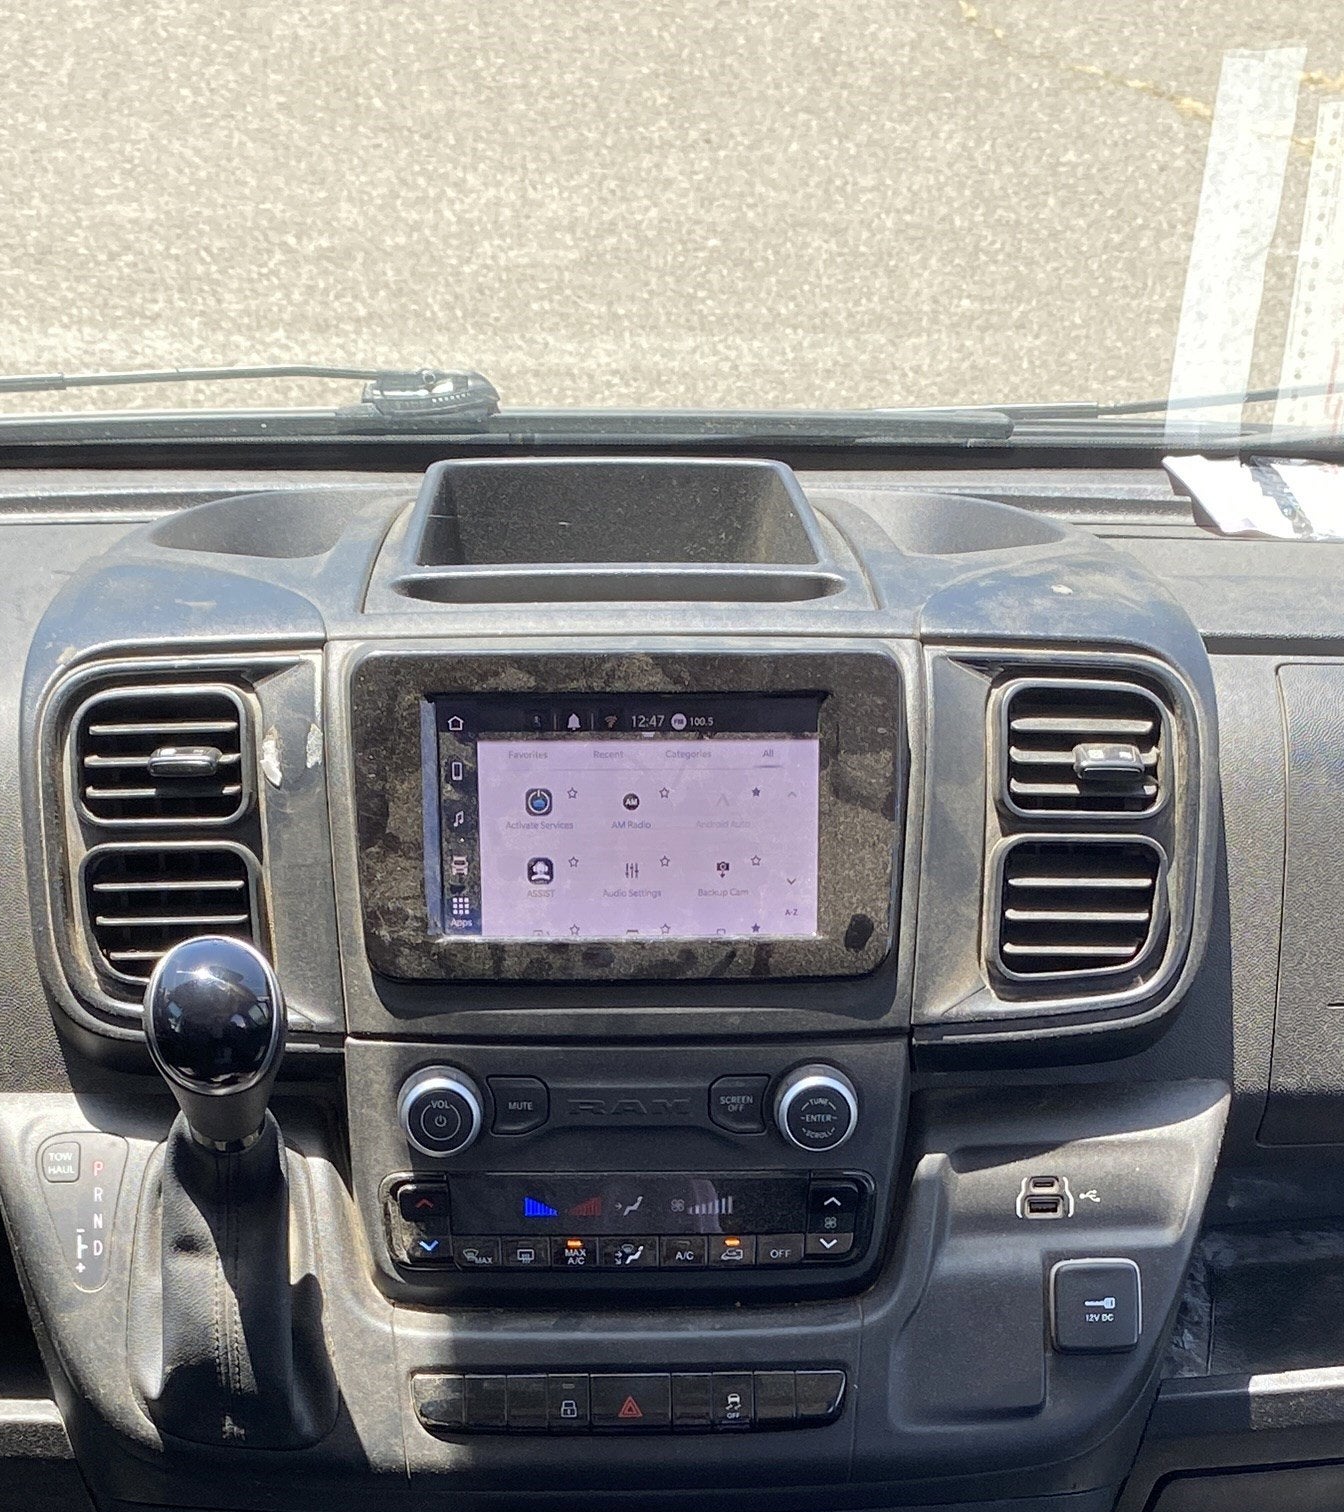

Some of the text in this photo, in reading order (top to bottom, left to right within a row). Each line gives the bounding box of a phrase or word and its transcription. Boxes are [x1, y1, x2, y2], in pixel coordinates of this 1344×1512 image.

[631, 715, 665, 728] 12:47
[690, 717, 715, 727] 100.5
[508, 750, 549, 760] Favorites
[593, 750, 624, 760] Recent
[665, 750, 712, 761] Categories
[762, 749, 775, 758] All
[506, 821, 574, 831] Activate Services
[611, 820, 652, 830] AM Radio
[603, 887, 663, 899] Audio Settings
[697, 887, 749, 898] Backup Cam
[785, 908, 799, 917] A-Z
[450, 918, 473, 928] Apps
[430, 1100, 451, 1110] VOL
[719, 1095, 754, 1105] SCREEN
[809, 1097, 829, 1106] TUNE
[508, 1101, 534, 1111] MUTE
[727, 1104, 744, 1112] OFF
[805, 1114, 832, 1123] ENTER
[805, 1130, 833, 1140] SCROLL
[48, 1152, 73, 1162] TOW
[47, 1165, 76, 1175] HAUL
[93, 1161, 103, 1175] P
[94, 1188, 103, 1202] R
[93, 1214, 103, 1228] N
[94, 1240, 103, 1257] D
[564, 1249, 586, 1257] MAX
[676, 1251, 694, 1260] A/C
[769, 1249, 791, 1259] OFF
[474, 1256, 493, 1265] MAX
[567, 1257, 585, 1265] A/C
[1085, 1313, 1114, 1323] 12V DC
